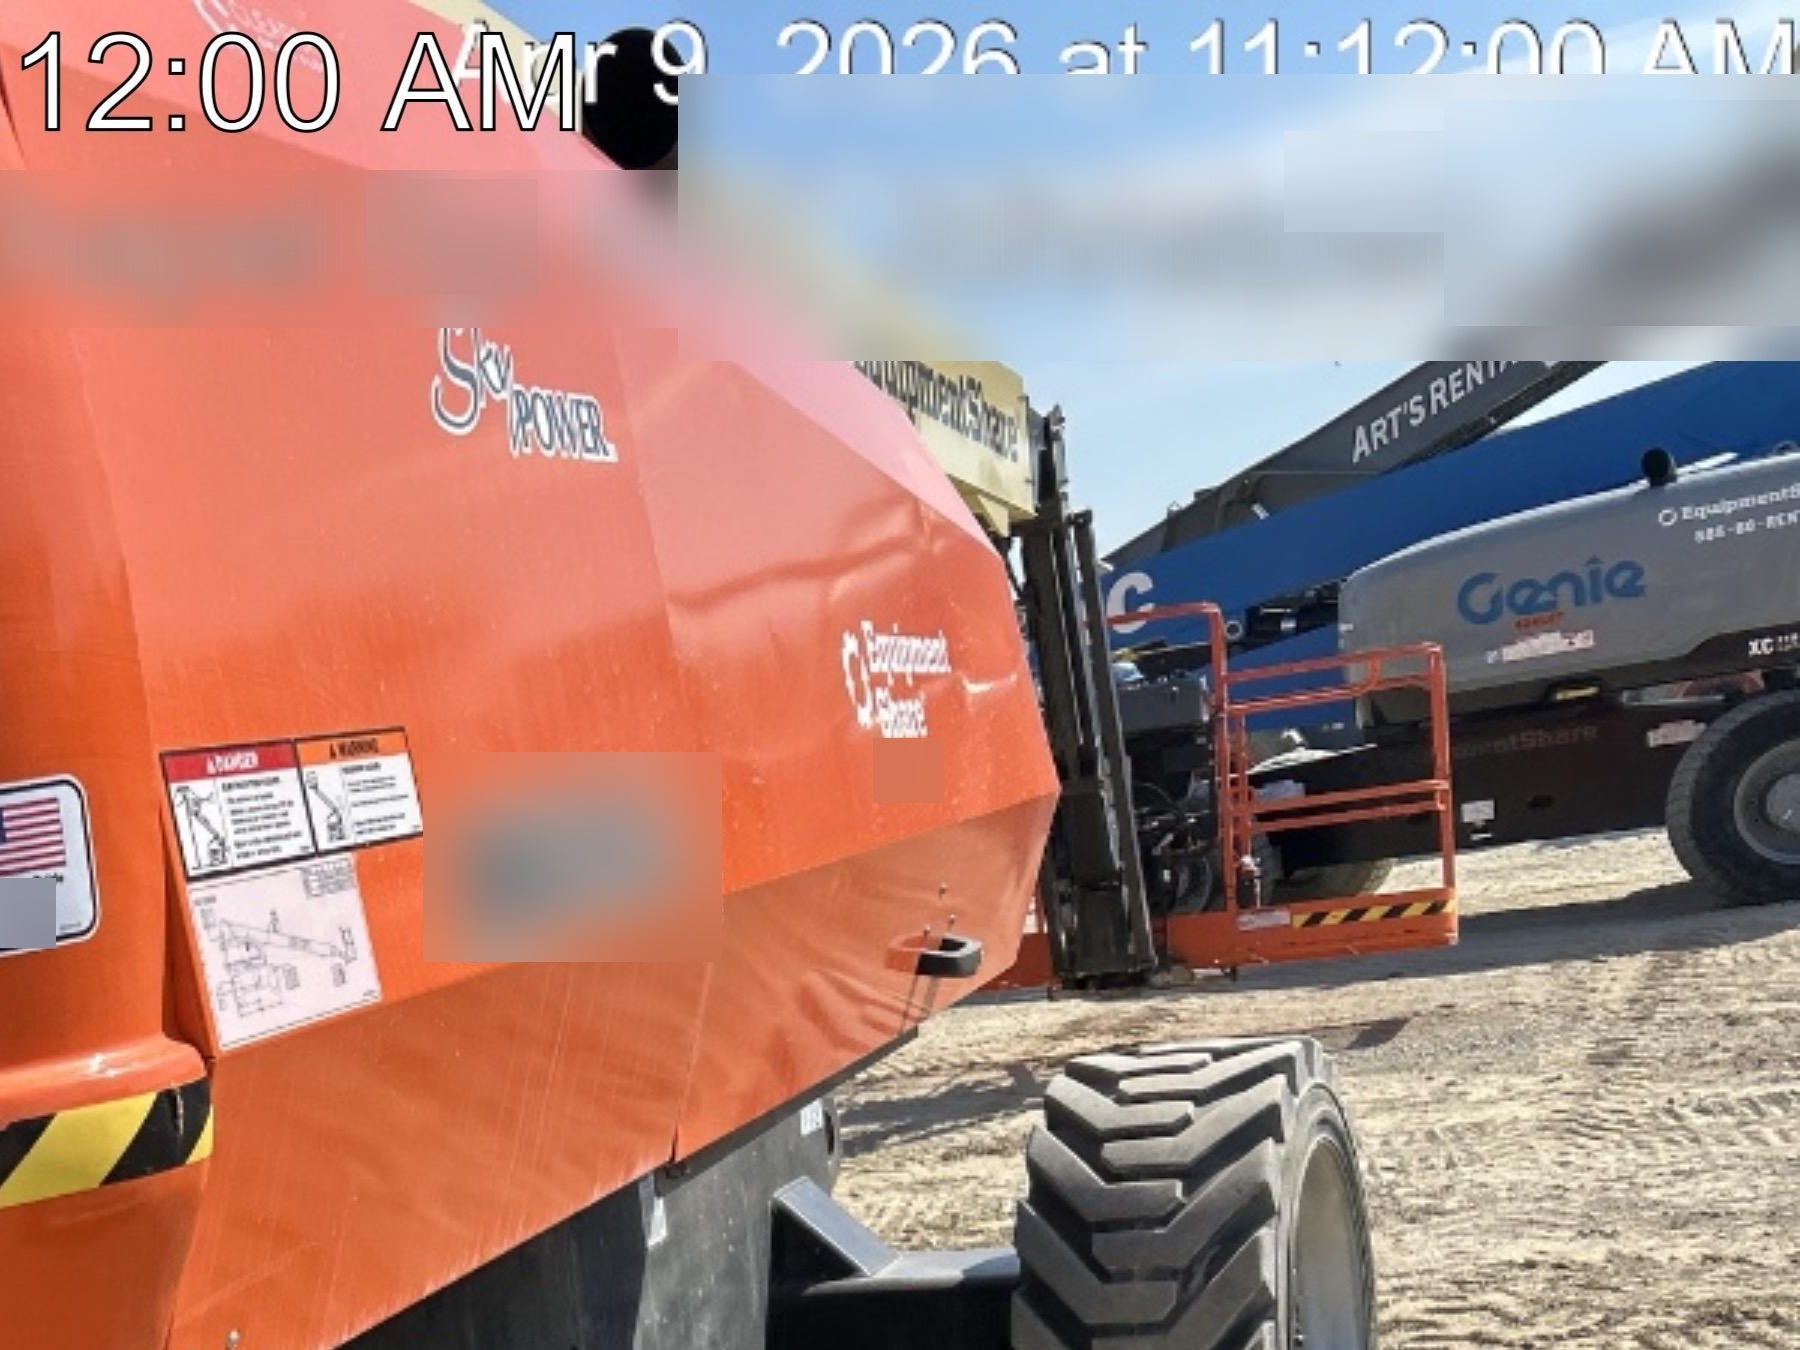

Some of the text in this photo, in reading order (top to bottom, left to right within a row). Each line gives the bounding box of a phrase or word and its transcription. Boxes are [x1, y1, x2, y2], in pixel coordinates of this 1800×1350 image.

[1352, 361, 1522, 464] ART'S RENT
[1457, 555, 1647, 626] Genie
